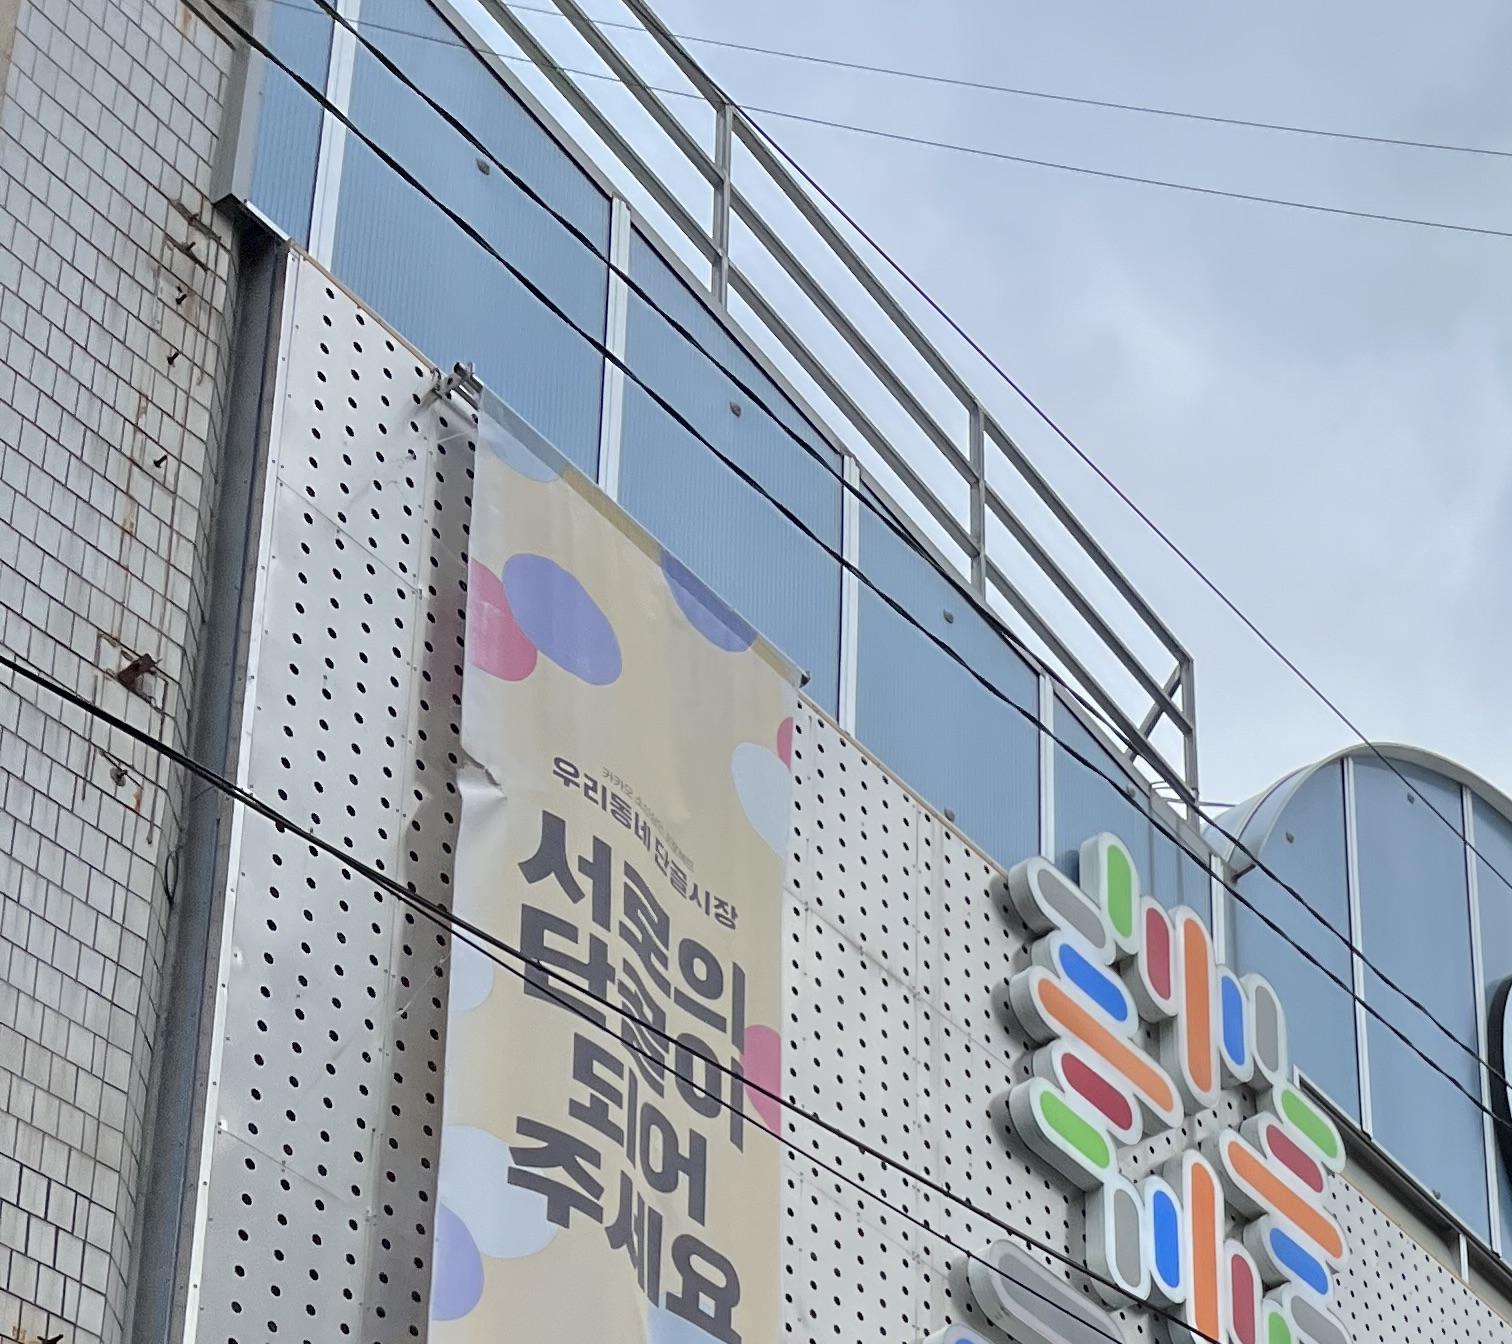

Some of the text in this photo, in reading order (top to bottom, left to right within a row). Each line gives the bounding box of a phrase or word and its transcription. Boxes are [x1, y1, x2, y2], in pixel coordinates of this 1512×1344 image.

[519, 809, 746, 1054] 서로의
[552, 756, 651, 853] 우리동네
[654, 835, 738, 930] 단골시장
[520, 903, 745, 1154] 단골이
[568, 1031, 708, 1227] 되어
